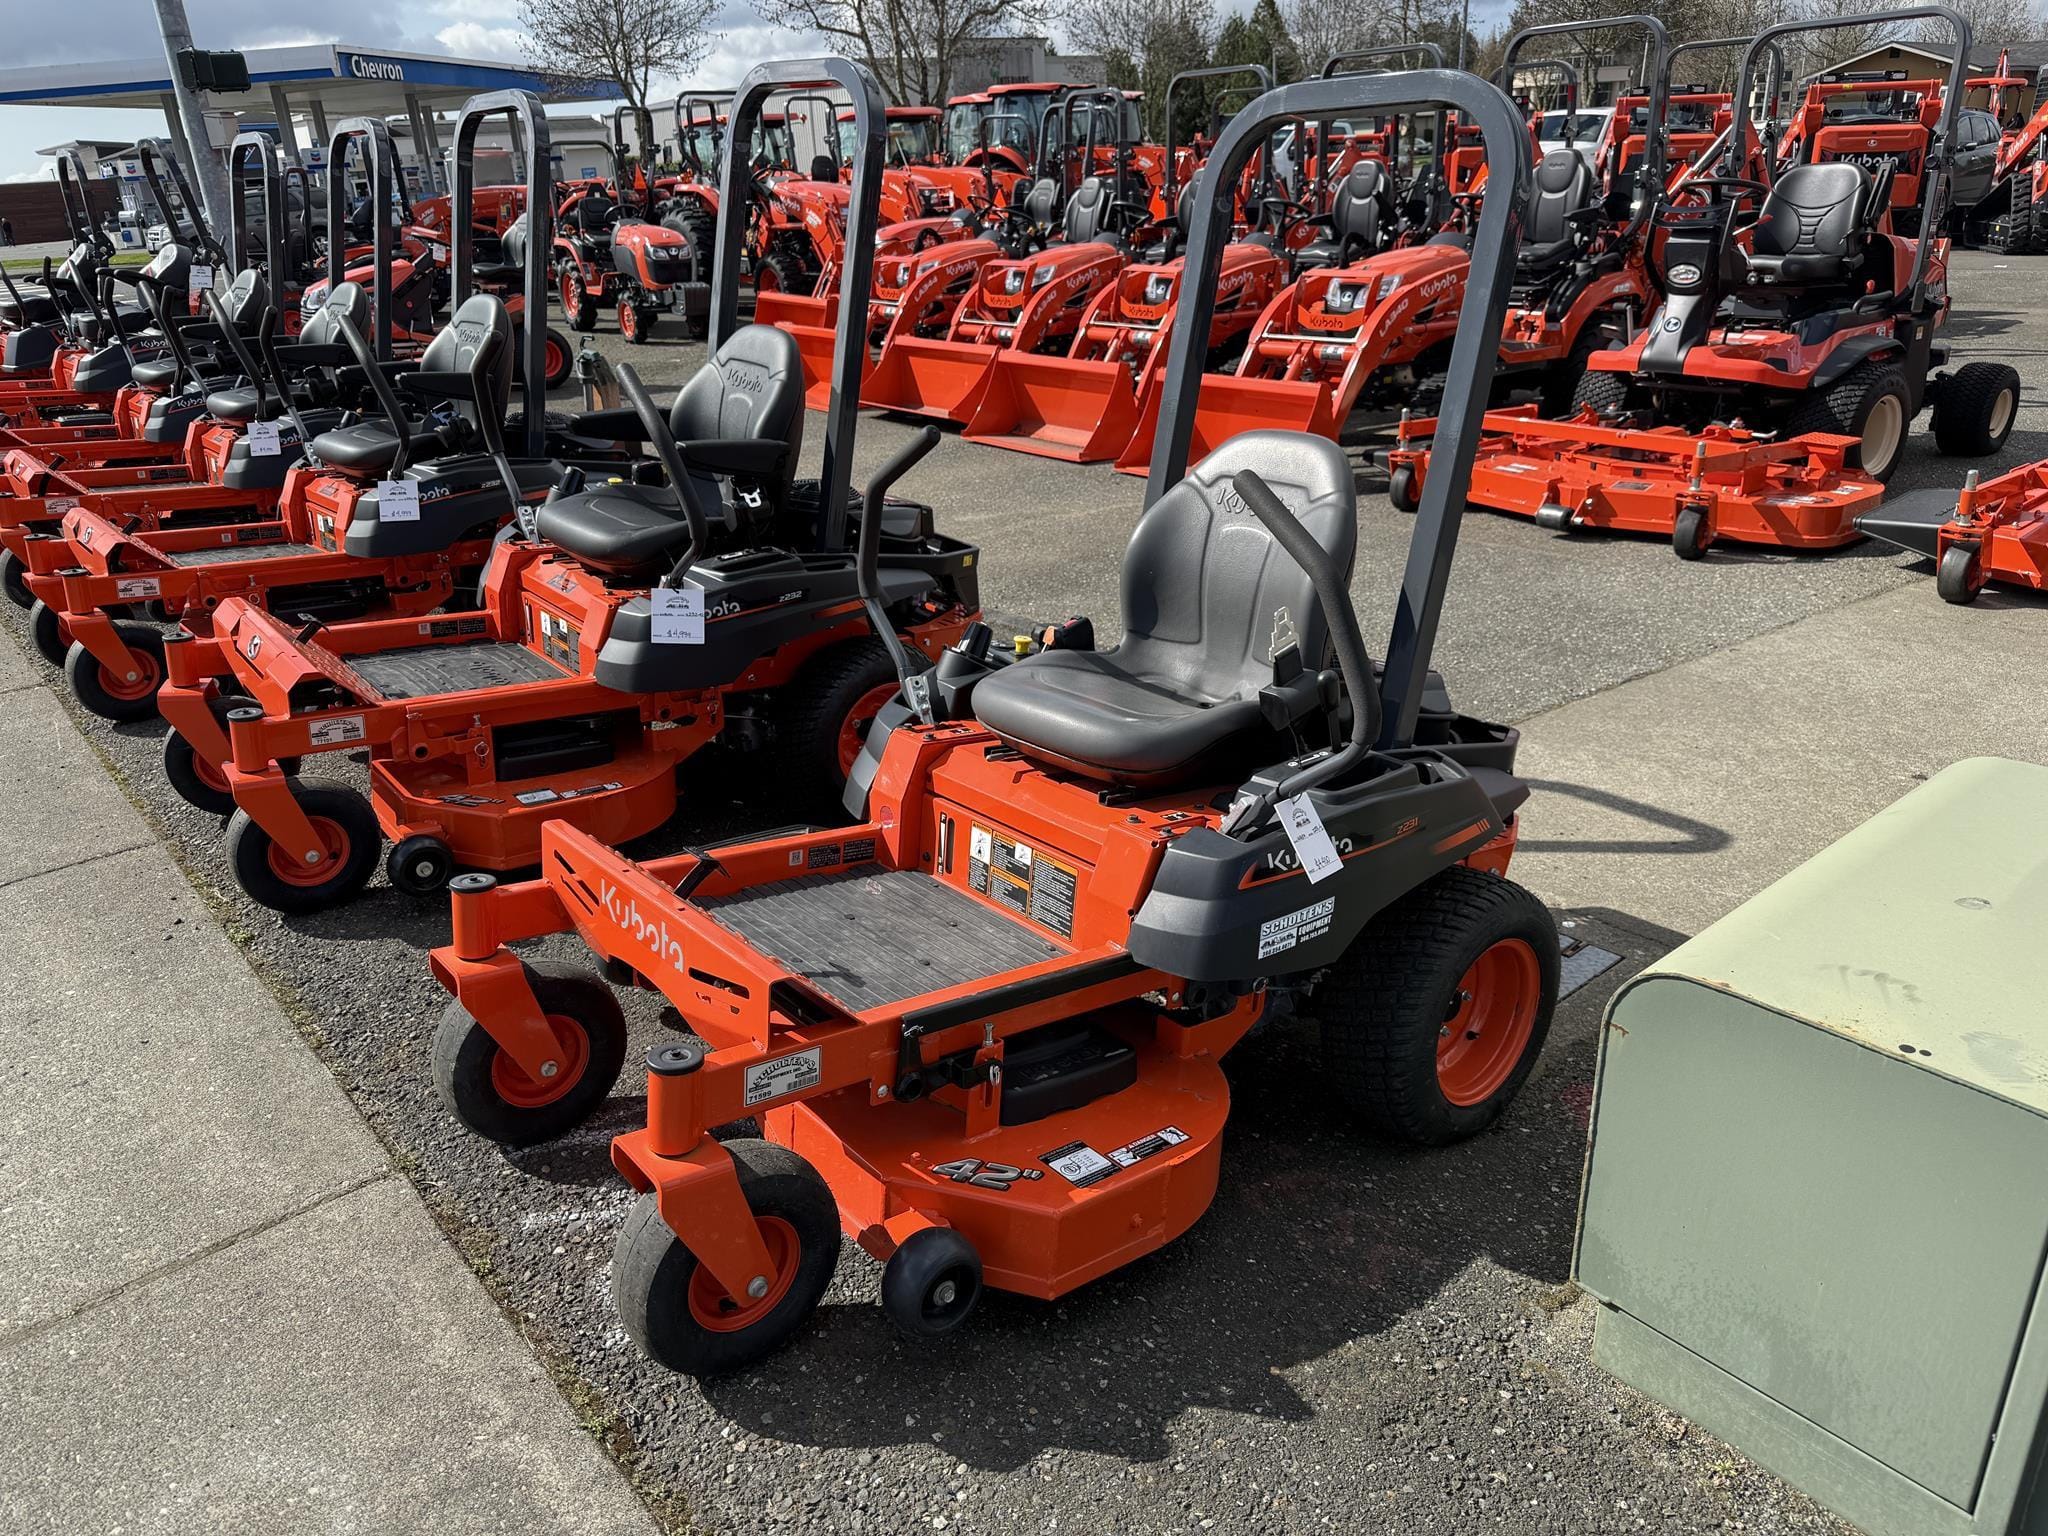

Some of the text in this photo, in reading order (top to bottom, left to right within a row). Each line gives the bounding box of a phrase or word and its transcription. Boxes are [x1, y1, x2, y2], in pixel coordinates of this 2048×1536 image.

[352, 55, 404, 80] Chevron
[945, 260, 979, 276] Kubota
[1067, 268, 1099, 289] Kubota
[1218, 271, 1254, 291] Kubota
[1420, 273, 1457, 297] Kubota
[1128, 307, 1154, 318] Kubota
[1310, 315, 1343, 329] Kubota
[1379, 298, 1409, 337] LA340
[727, 368, 764, 393] Kubota
[1267, 836, 1353, 871] Kuta
[601, 879, 684, 973] Kubota
[1262, 900, 1333, 937] SCHOLTEN'S
[1298, 915, 1332, 936] EQUIPMENT
[753, 1057, 816, 1087] SCHOLTEN'S
[930, 1158, 1045, 1192] 42"
